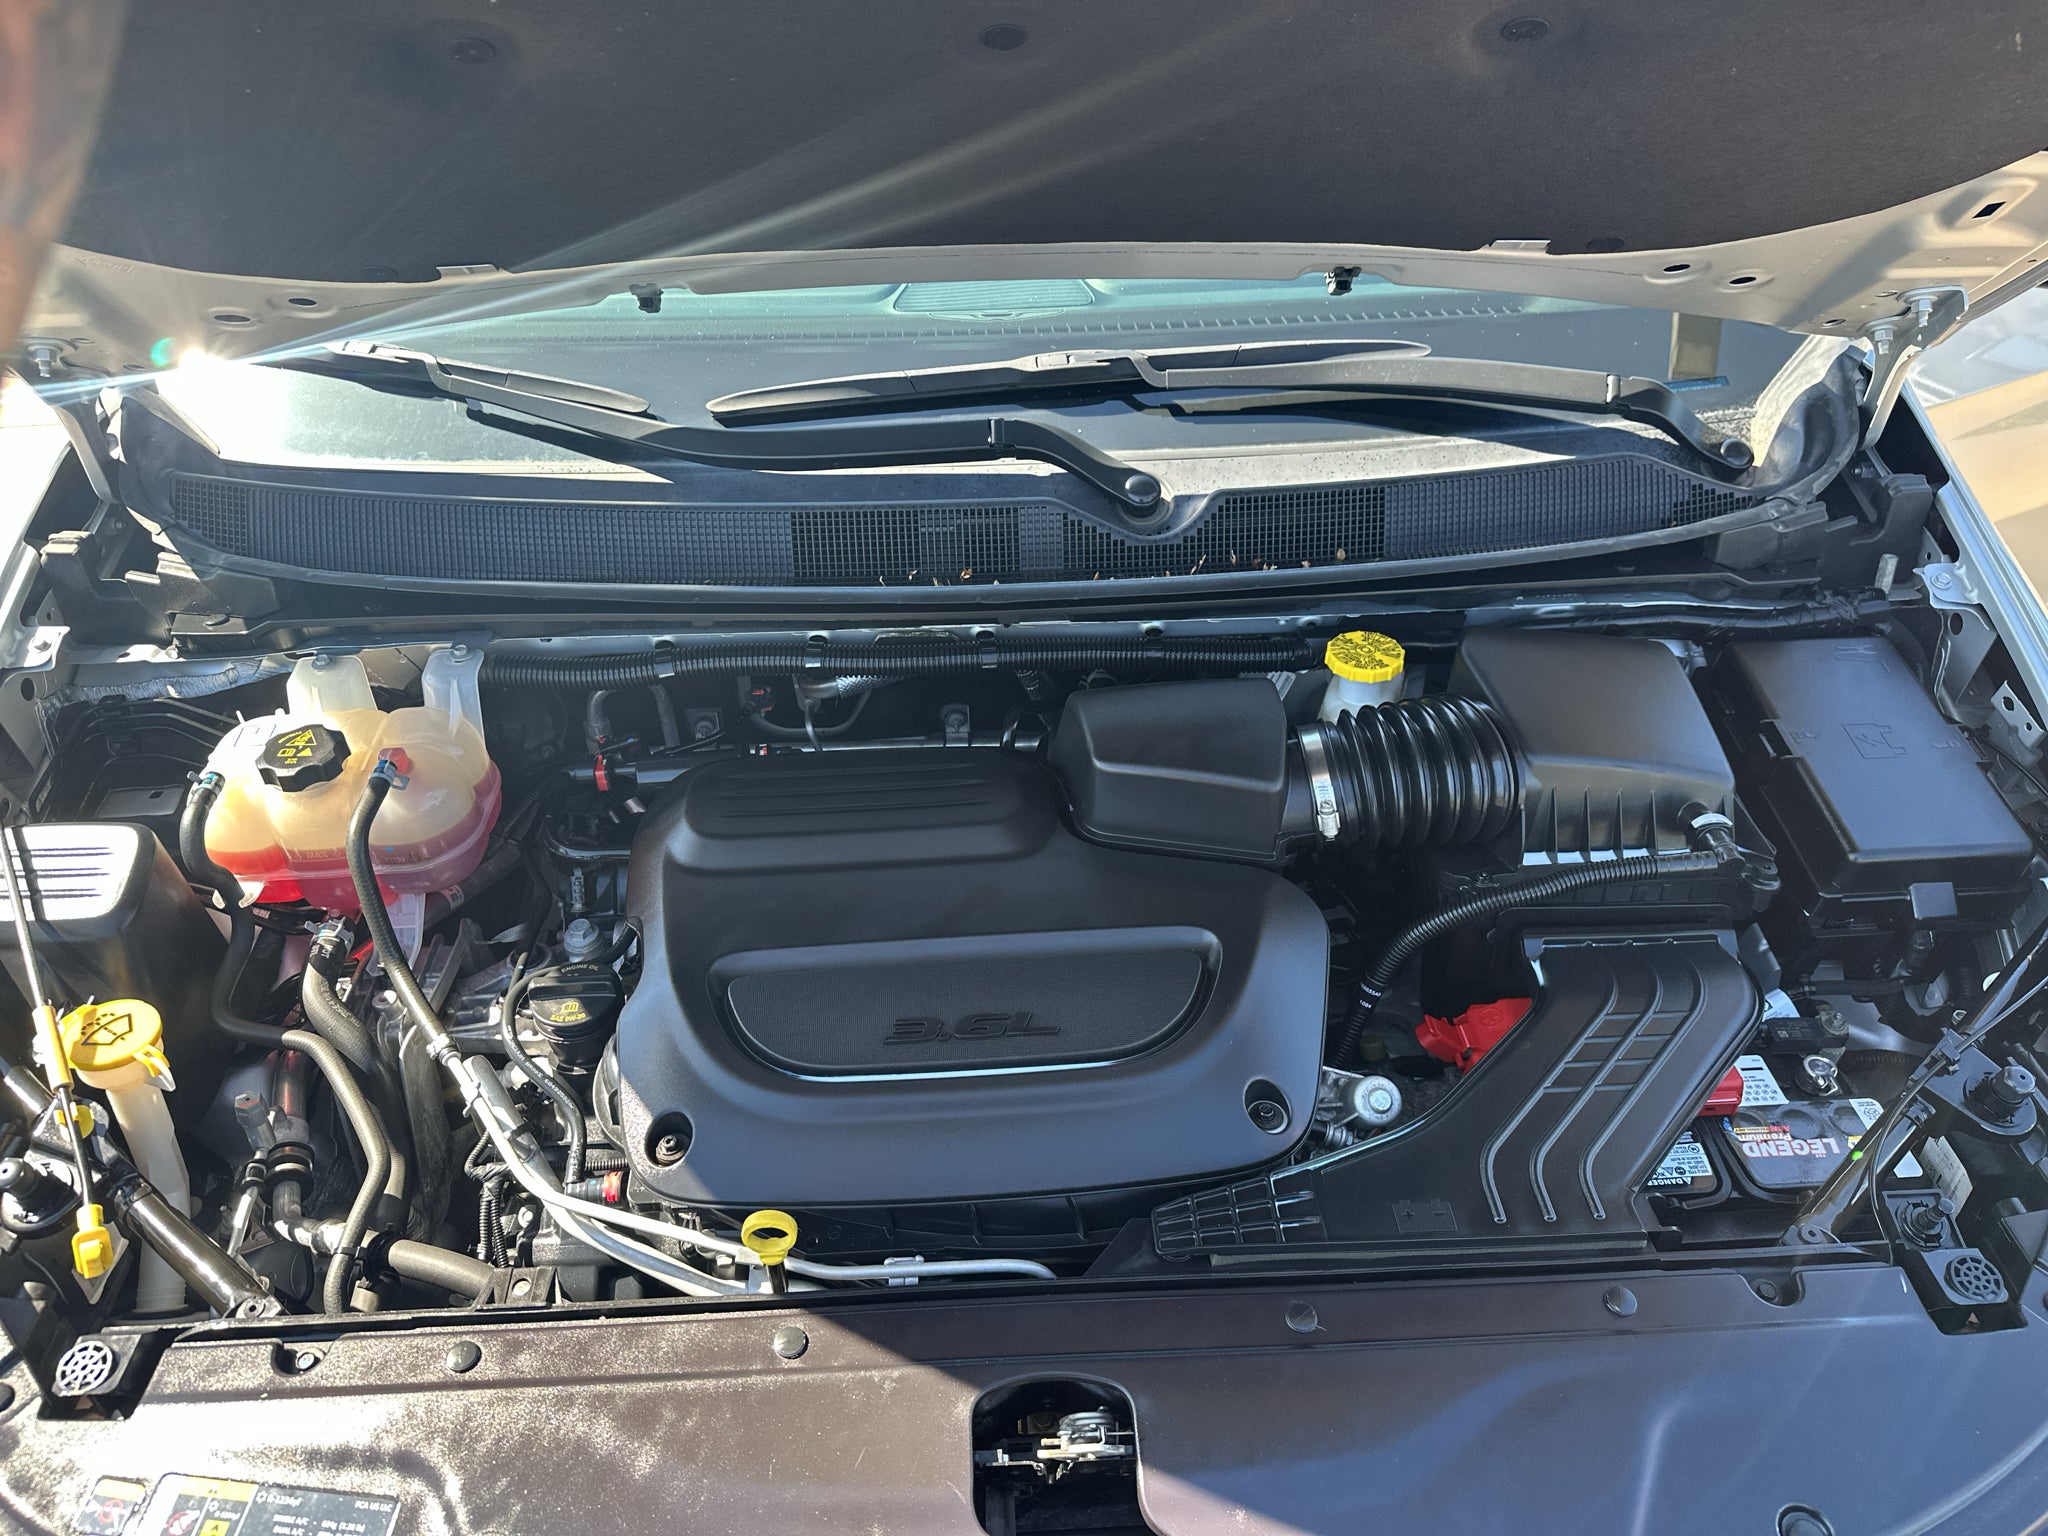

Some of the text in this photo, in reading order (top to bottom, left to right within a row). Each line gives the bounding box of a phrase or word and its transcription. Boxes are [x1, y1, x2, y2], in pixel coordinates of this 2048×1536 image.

[561, 962, 600, 973] ENGINE OIL
[550, 1012, 586, 1022] SAE 0W-20
[882, 1010, 1061, 1046] 3.6L
[525, 1061, 543, 1079] BRAKE
[1737, 1132, 1792, 1142] Premium
[1742, 1136, 1841, 1158] LEGEND
[354, 1500, 393, 1513] FCA US LLC
[295, 1516, 310, 1526] A/C
